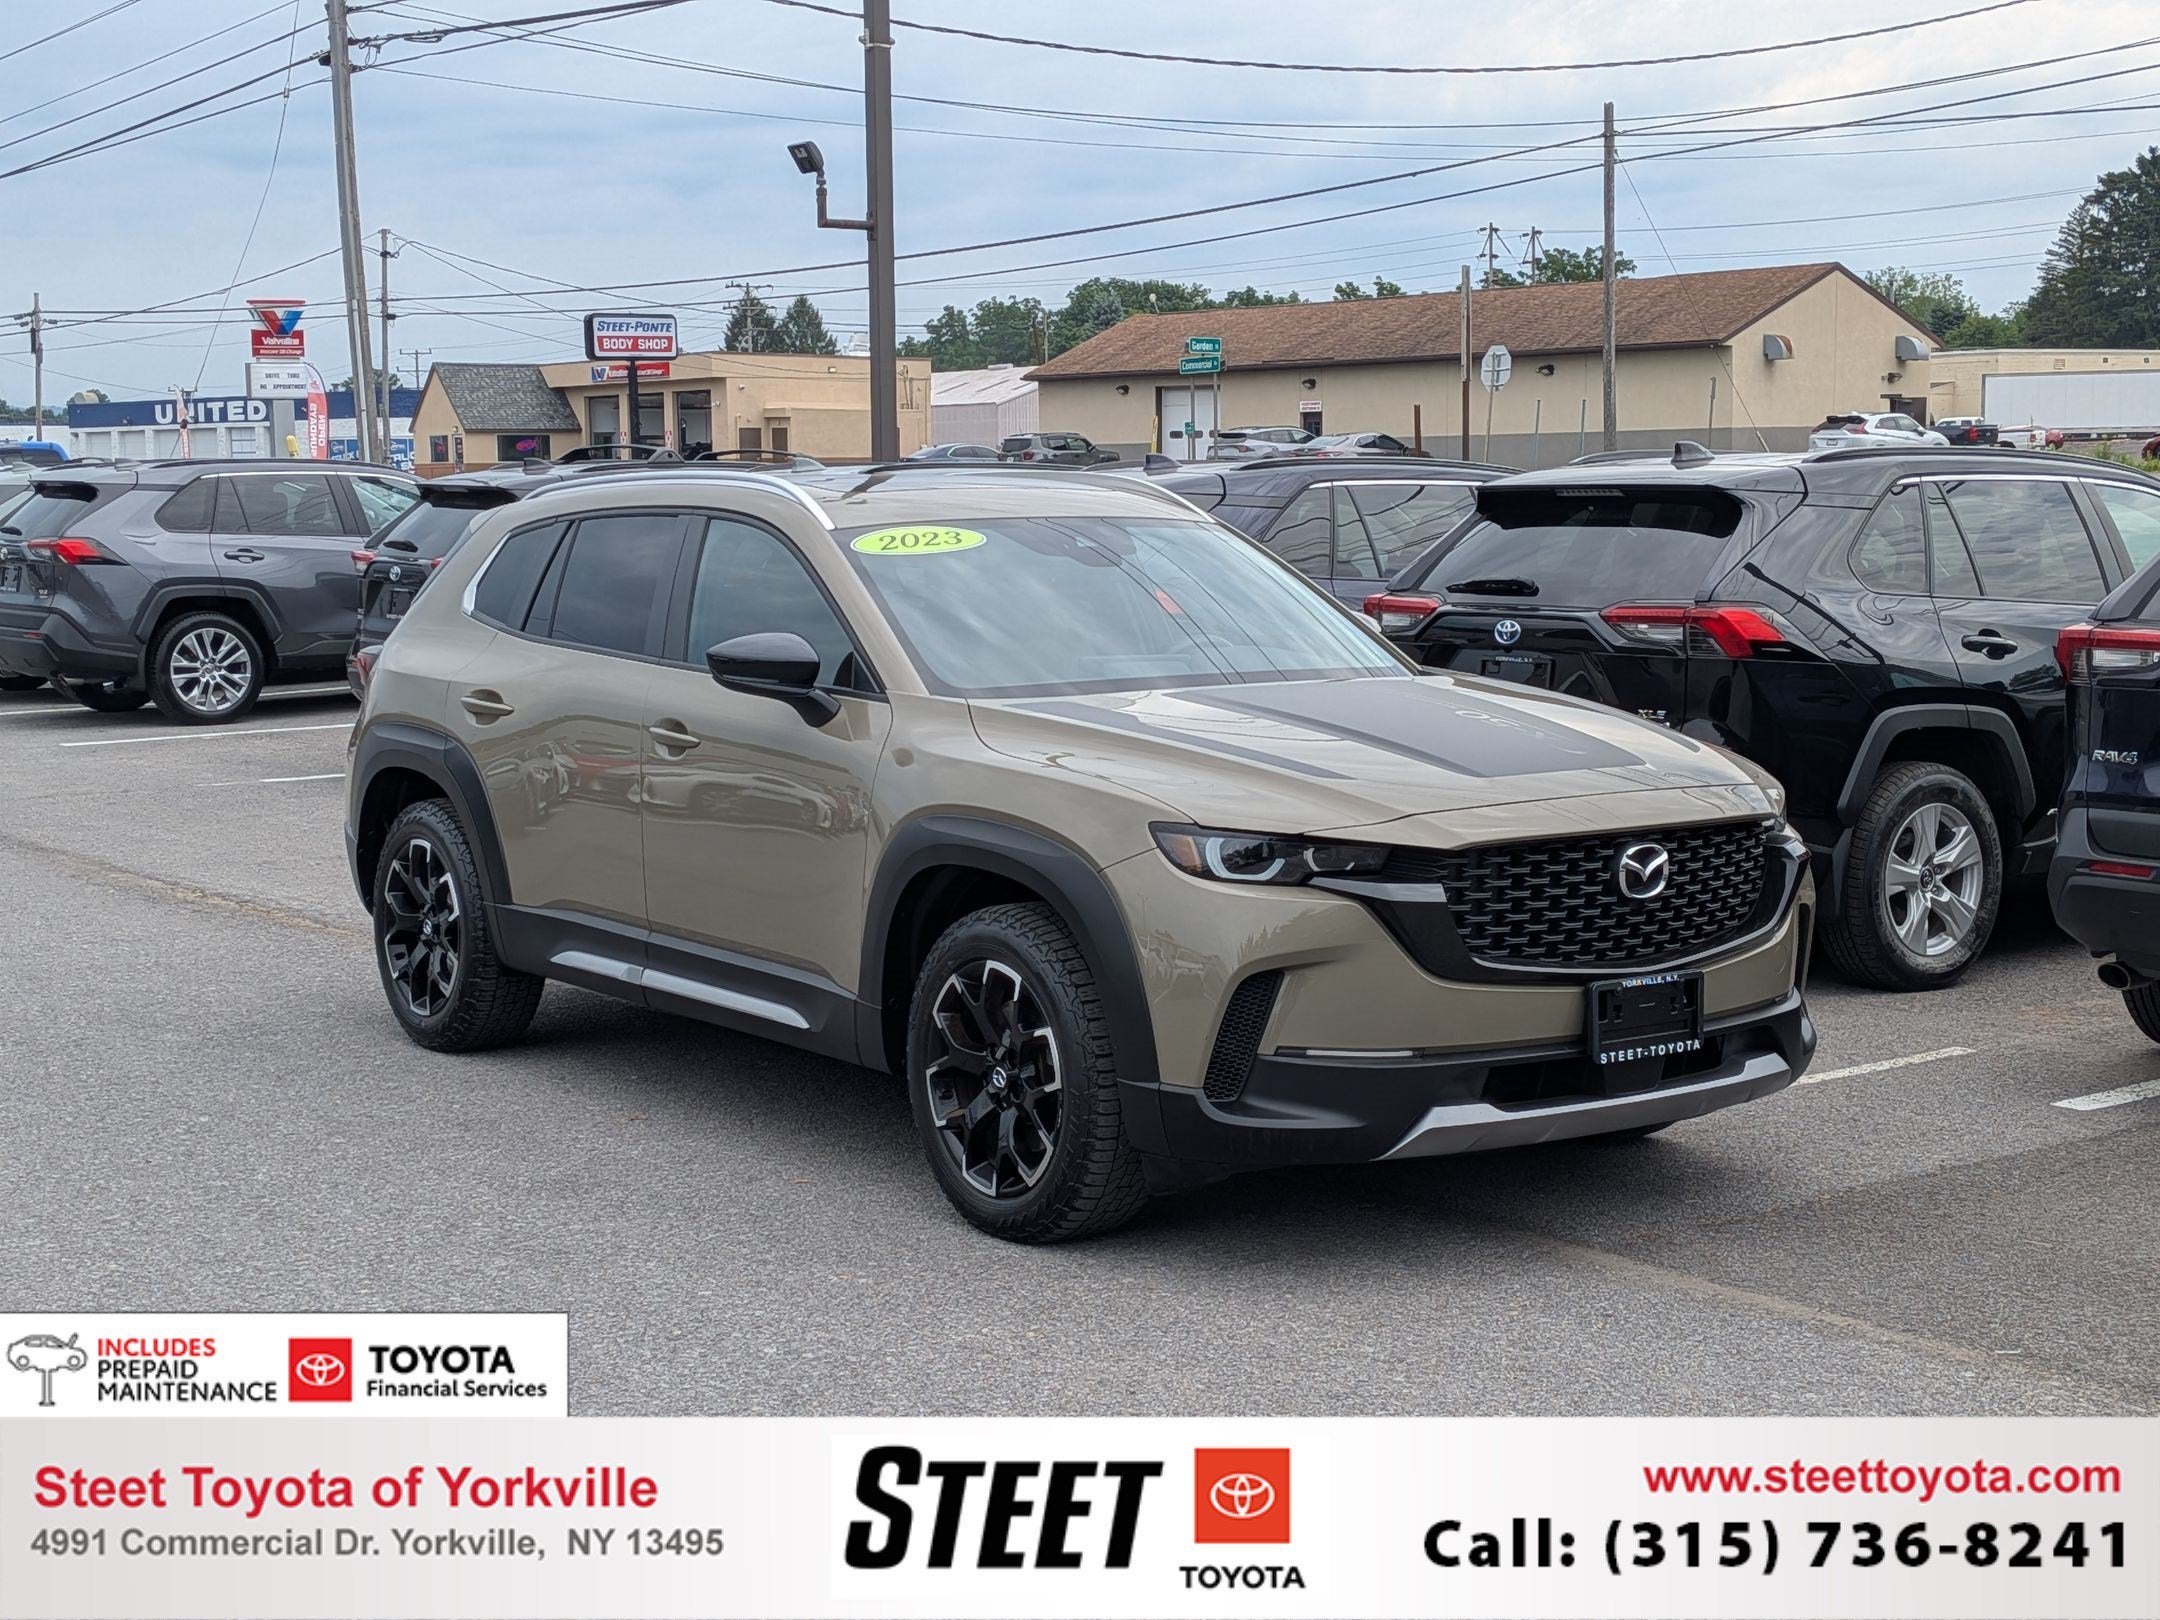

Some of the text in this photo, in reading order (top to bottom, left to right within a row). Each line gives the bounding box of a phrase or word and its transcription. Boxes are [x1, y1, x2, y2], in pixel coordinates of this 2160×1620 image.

[597, 320, 673, 333] STEET-PONTE
[602, 338, 669, 350] BODY SHOP
[879, 530, 962, 551] 2023
[1600, 1039, 1701, 1064] STEET-TOYOTA
